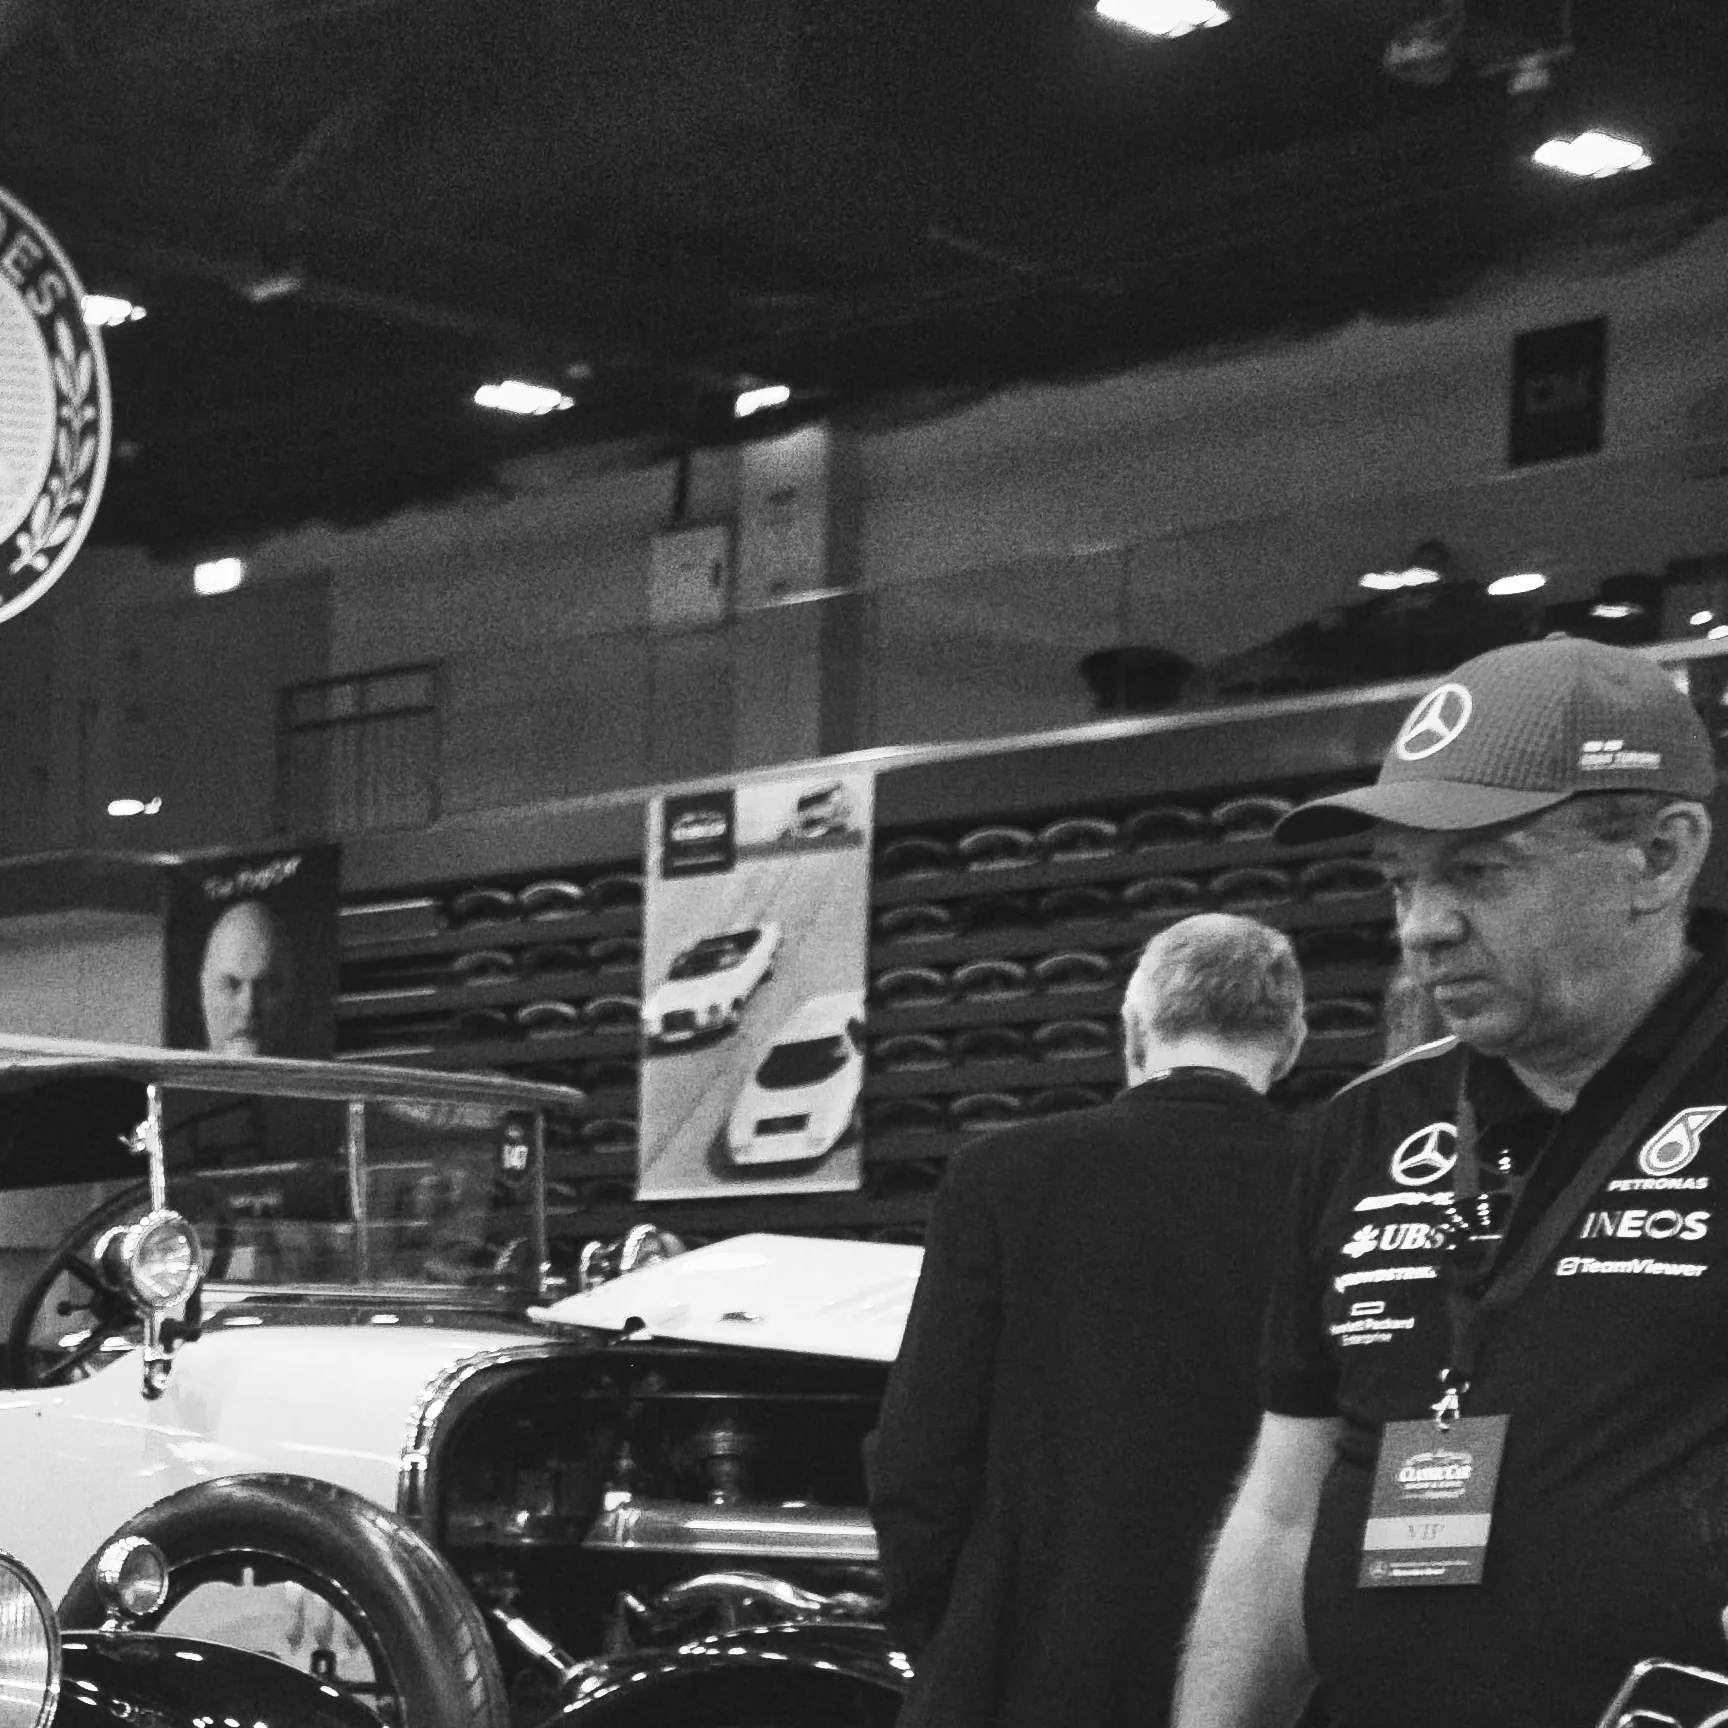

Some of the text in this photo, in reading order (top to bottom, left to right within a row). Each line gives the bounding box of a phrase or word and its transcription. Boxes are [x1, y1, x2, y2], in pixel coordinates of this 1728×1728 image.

[1607, 1177, 1710, 1192] PETRONAS
[1379, 1223, 1445, 1251] UBS
[1580, 1210, 1712, 1241] INEOS
[1580, 1258, 1709, 1277] TeamViewer
